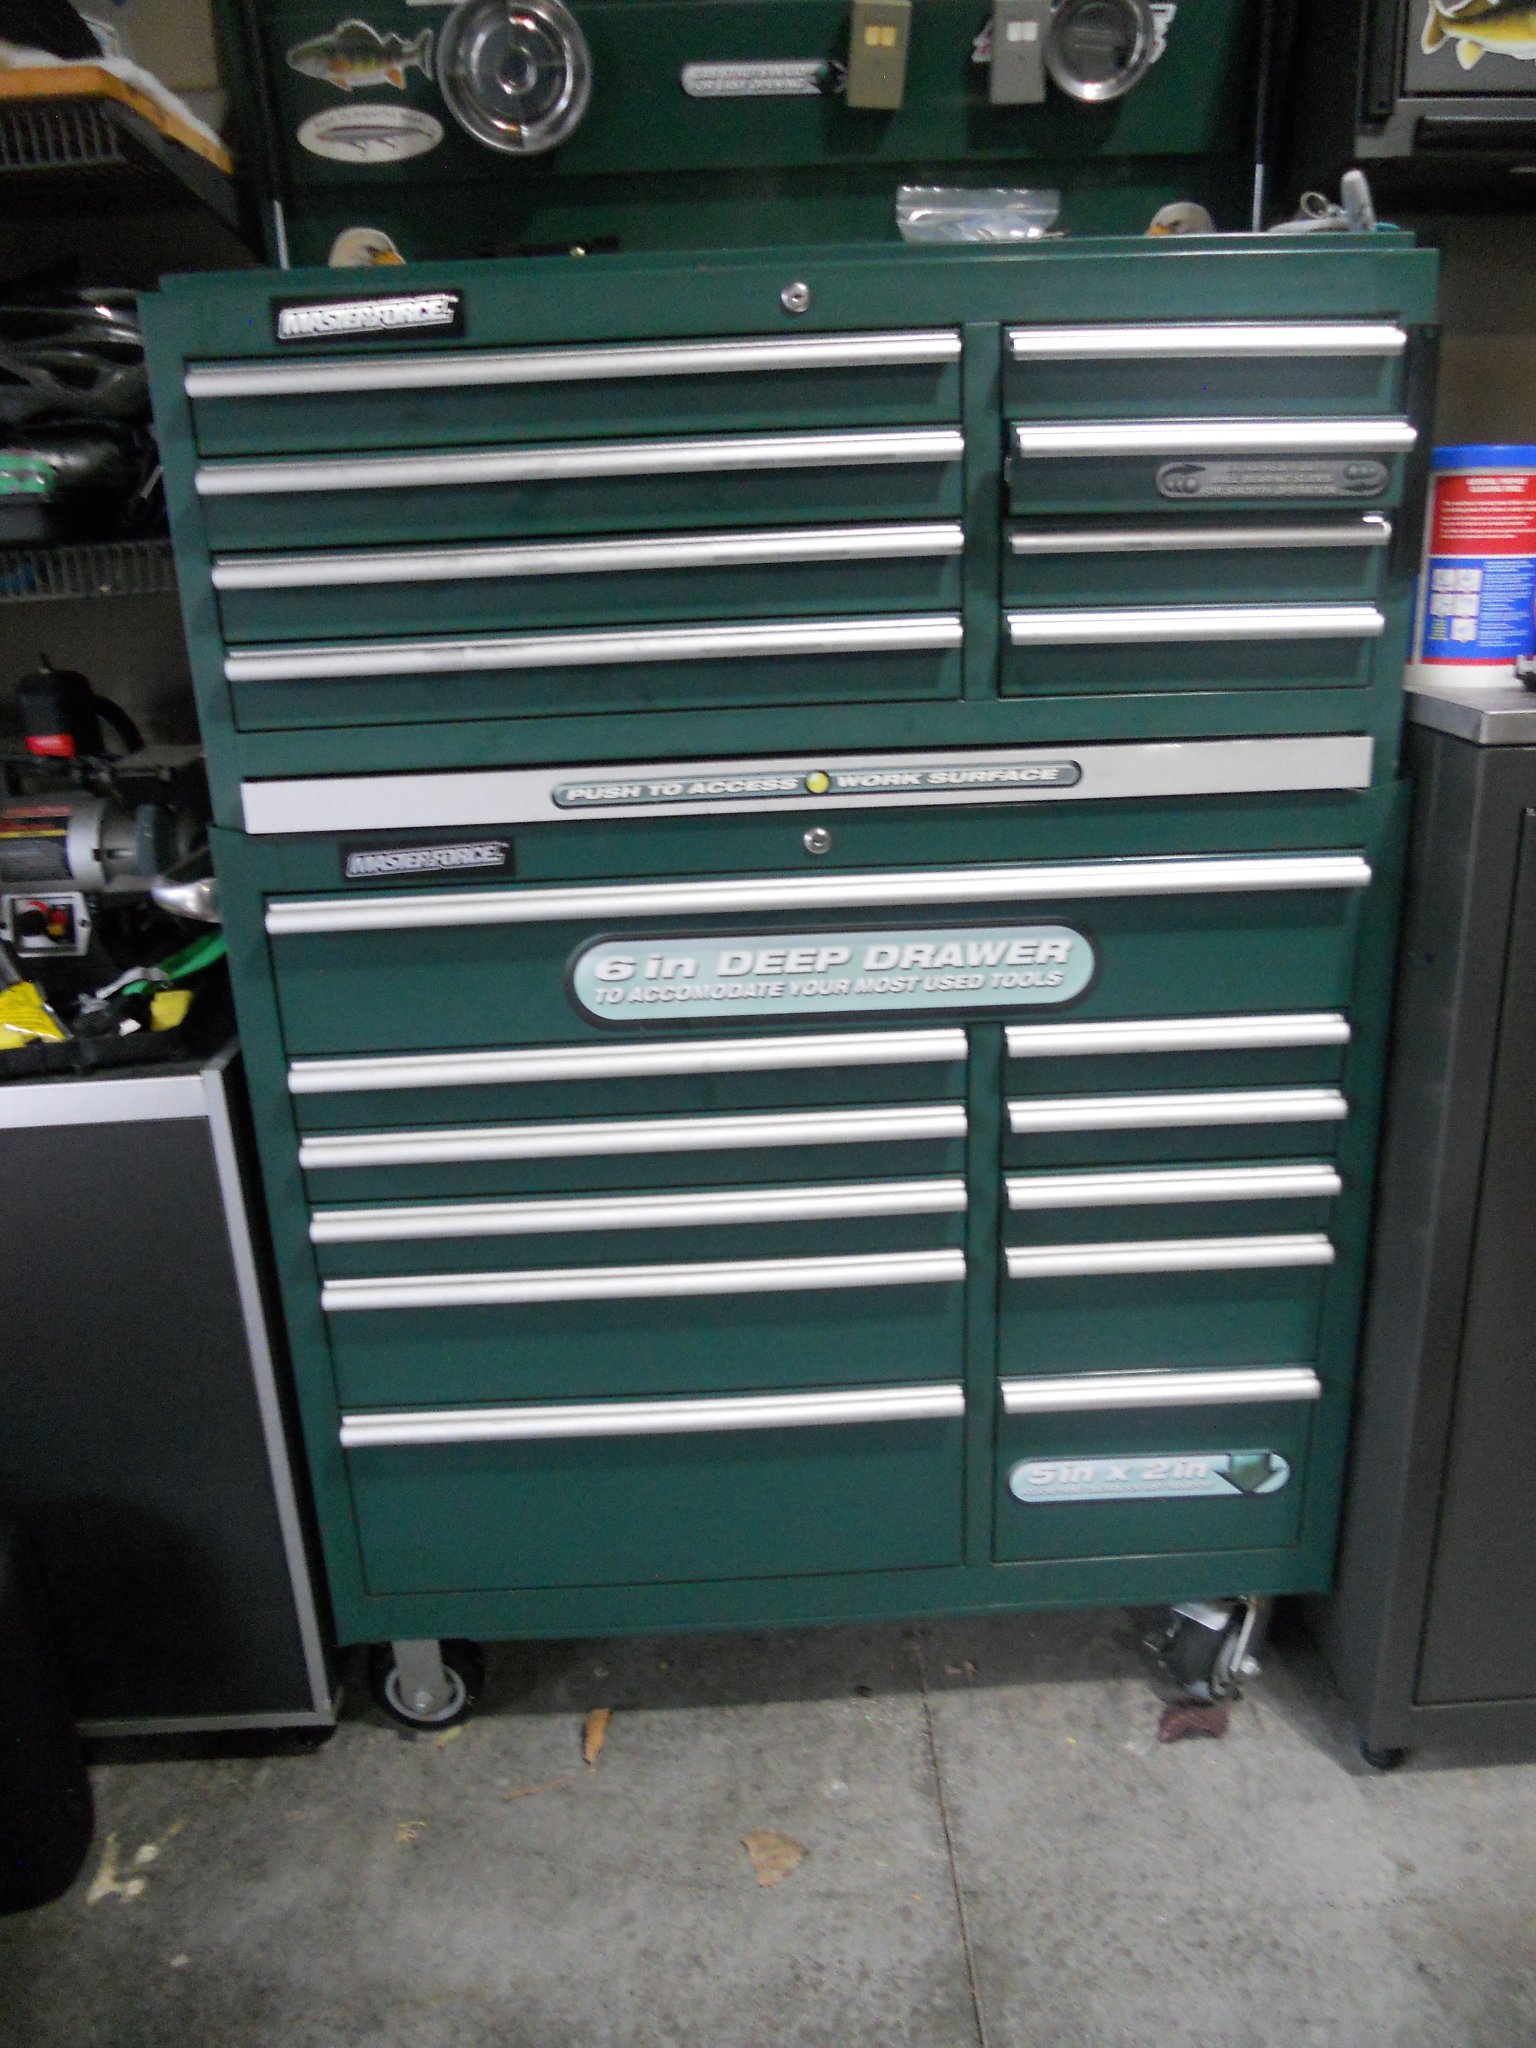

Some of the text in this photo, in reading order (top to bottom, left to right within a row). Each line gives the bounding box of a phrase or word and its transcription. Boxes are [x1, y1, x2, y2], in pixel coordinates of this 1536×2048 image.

[565, 768, 1061, 801] PUSH TO ACCESS WORK SURFACE
[595, 938, 1073, 982] 6 in DEEP DRAWER
[595, 970, 1065, 1004] TO ACCOMODATE YOUR MOST USED TOOLS
